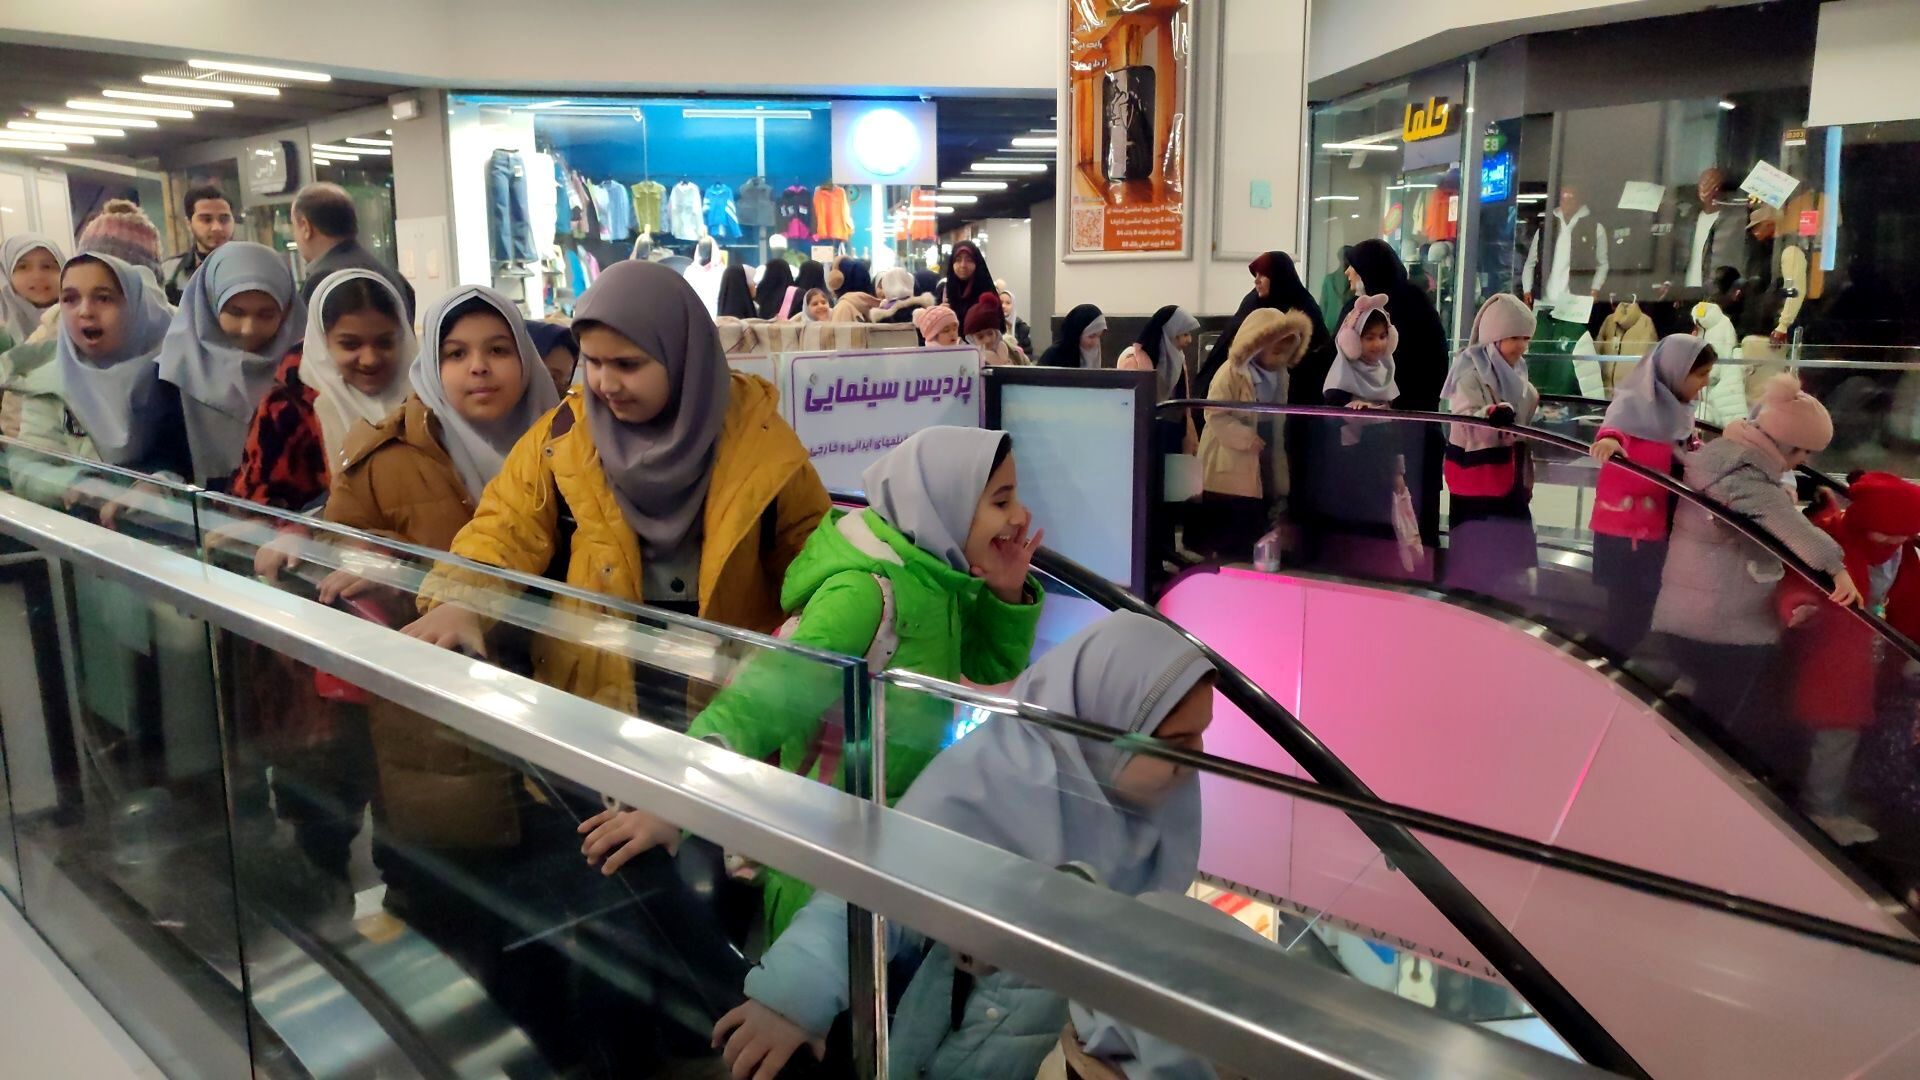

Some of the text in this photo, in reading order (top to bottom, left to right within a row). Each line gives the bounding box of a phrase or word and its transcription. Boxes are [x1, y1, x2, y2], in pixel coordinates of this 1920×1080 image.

[805, 375, 972, 412] پردیس سینمایی
[810, 443, 839, 458] خارجی
[848, 439, 873, 453] ایرانی
